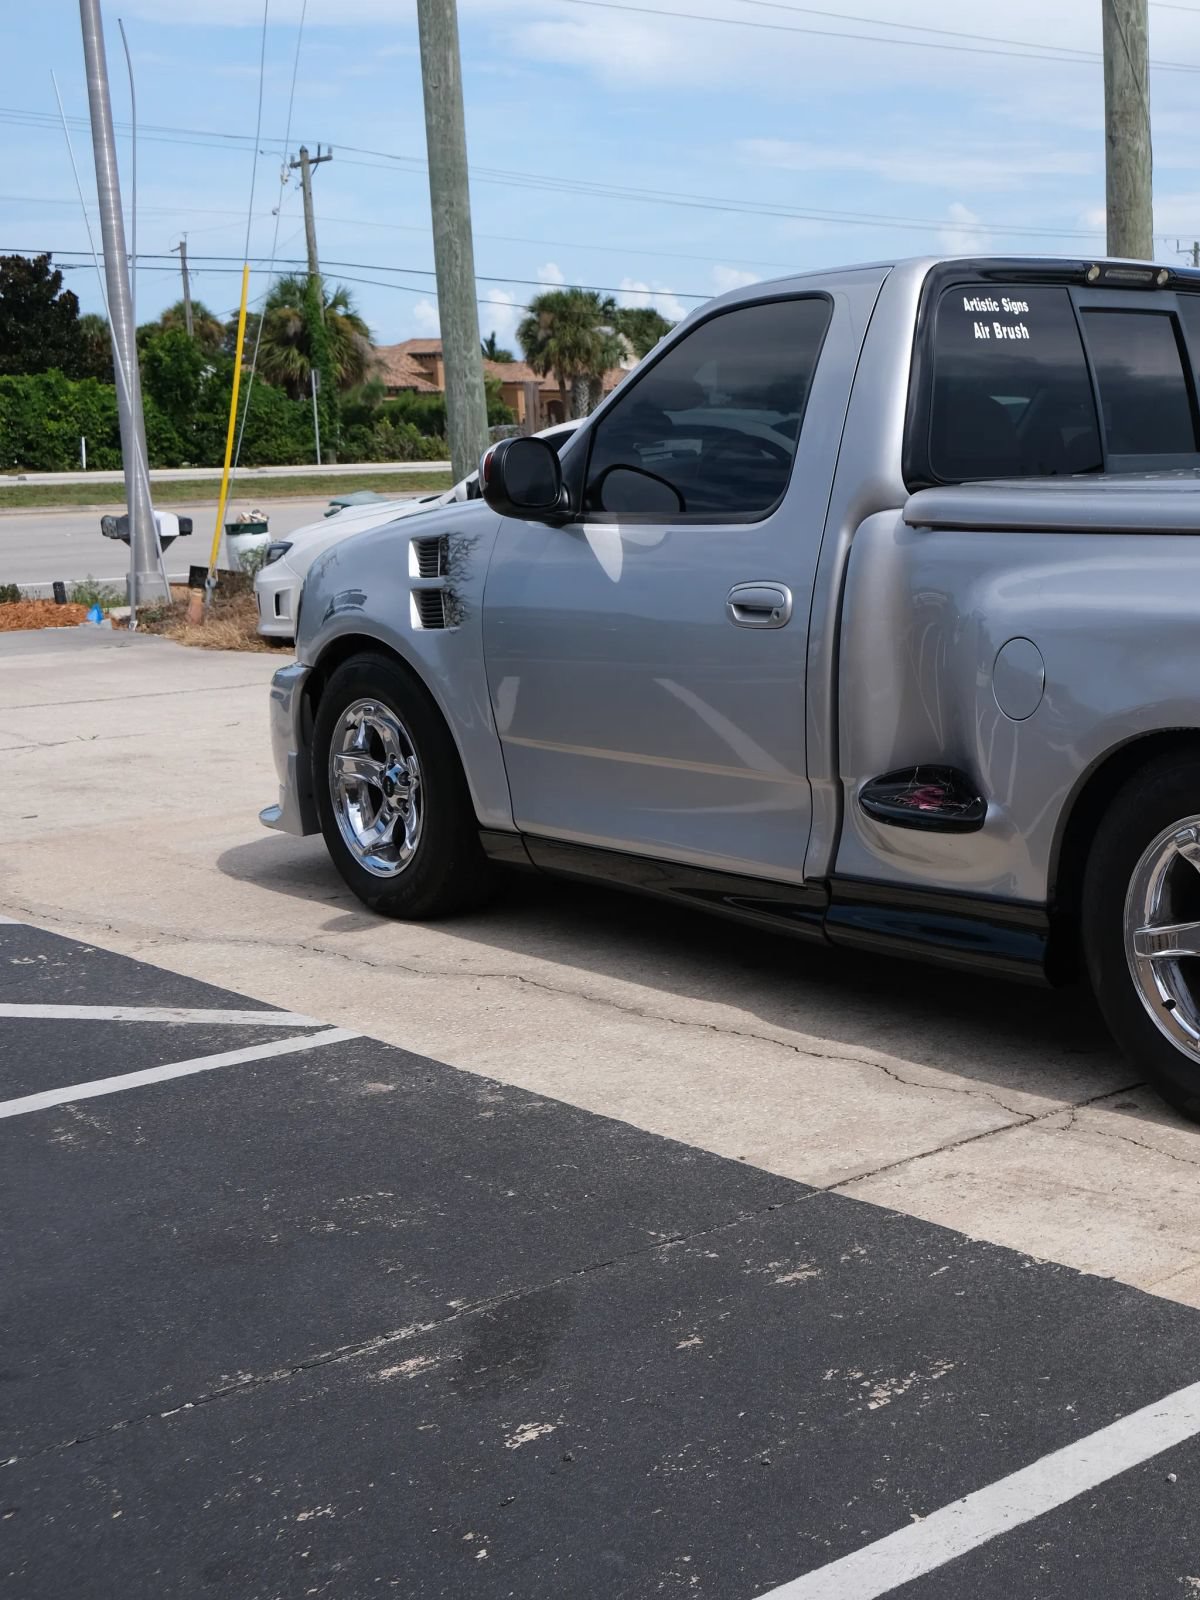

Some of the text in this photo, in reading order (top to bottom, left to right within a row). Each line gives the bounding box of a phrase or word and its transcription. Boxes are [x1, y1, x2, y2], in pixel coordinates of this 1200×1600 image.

[963, 297, 1029, 315] Artistic Signs
[973, 322, 1030, 340] Air Brush
